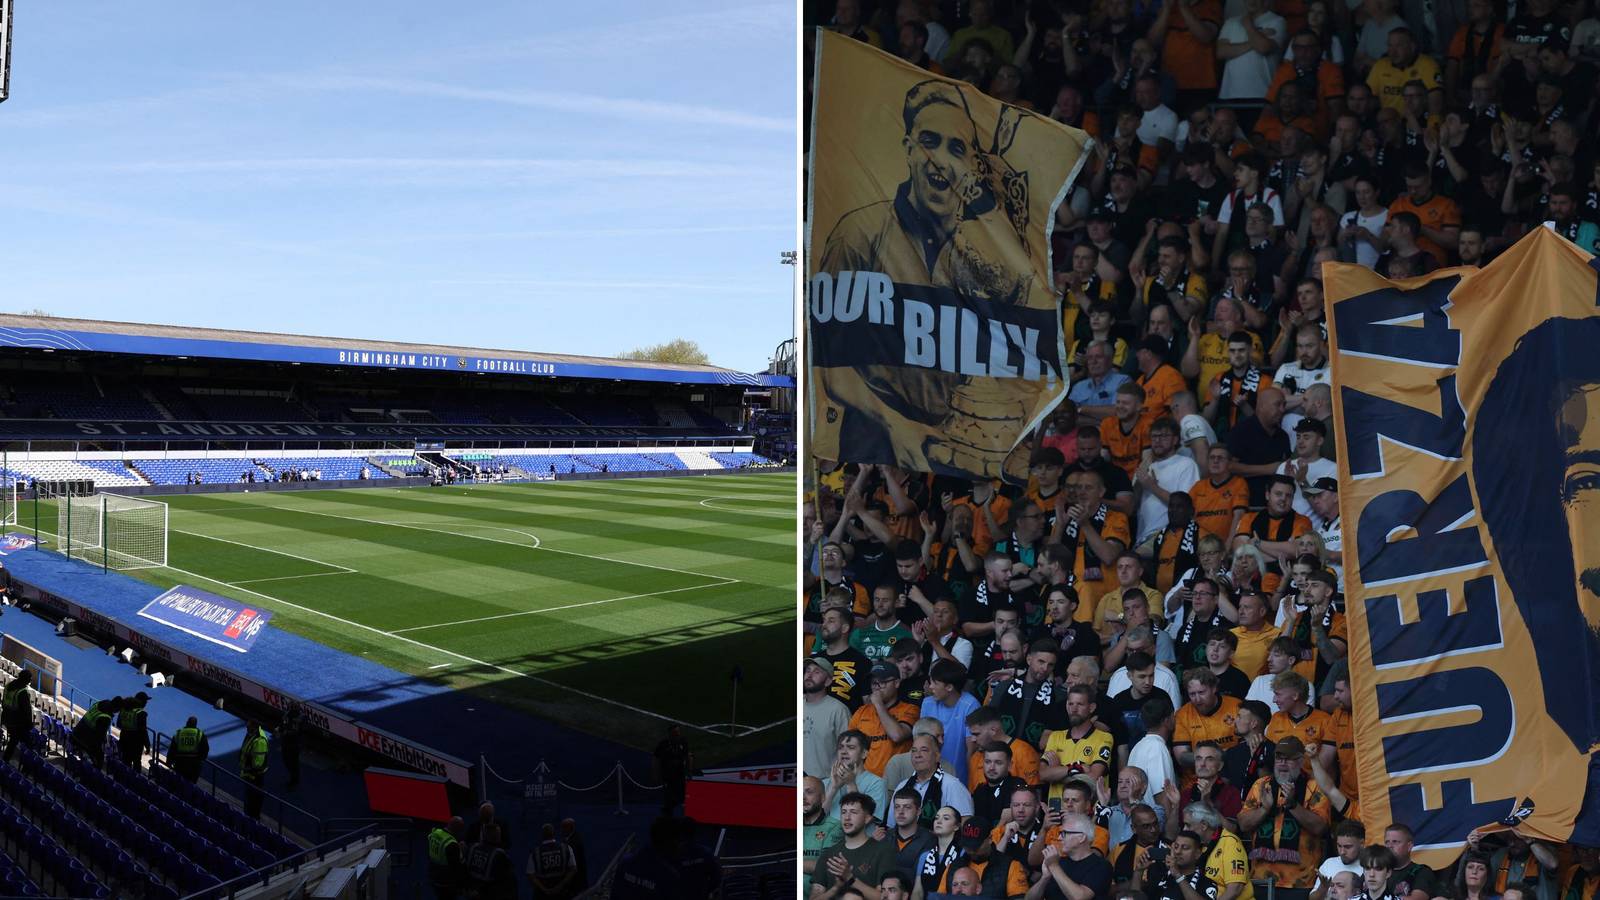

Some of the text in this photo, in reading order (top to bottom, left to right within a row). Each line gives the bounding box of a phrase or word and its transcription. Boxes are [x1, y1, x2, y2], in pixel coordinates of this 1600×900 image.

[811, 269, 894, 324] OUR
[339, 351, 555, 375] BIRMINGHAM CITY FOOTBALL CLUB
[1333, 274, 1517, 852] FUERZA
[188, 655, 243, 692] DCE Exhibitions
[263, 687, 281, 710] DCE
[358, 726, 448, 778] DCE Exhibitions
[803, 849, 820, 857] NITE
